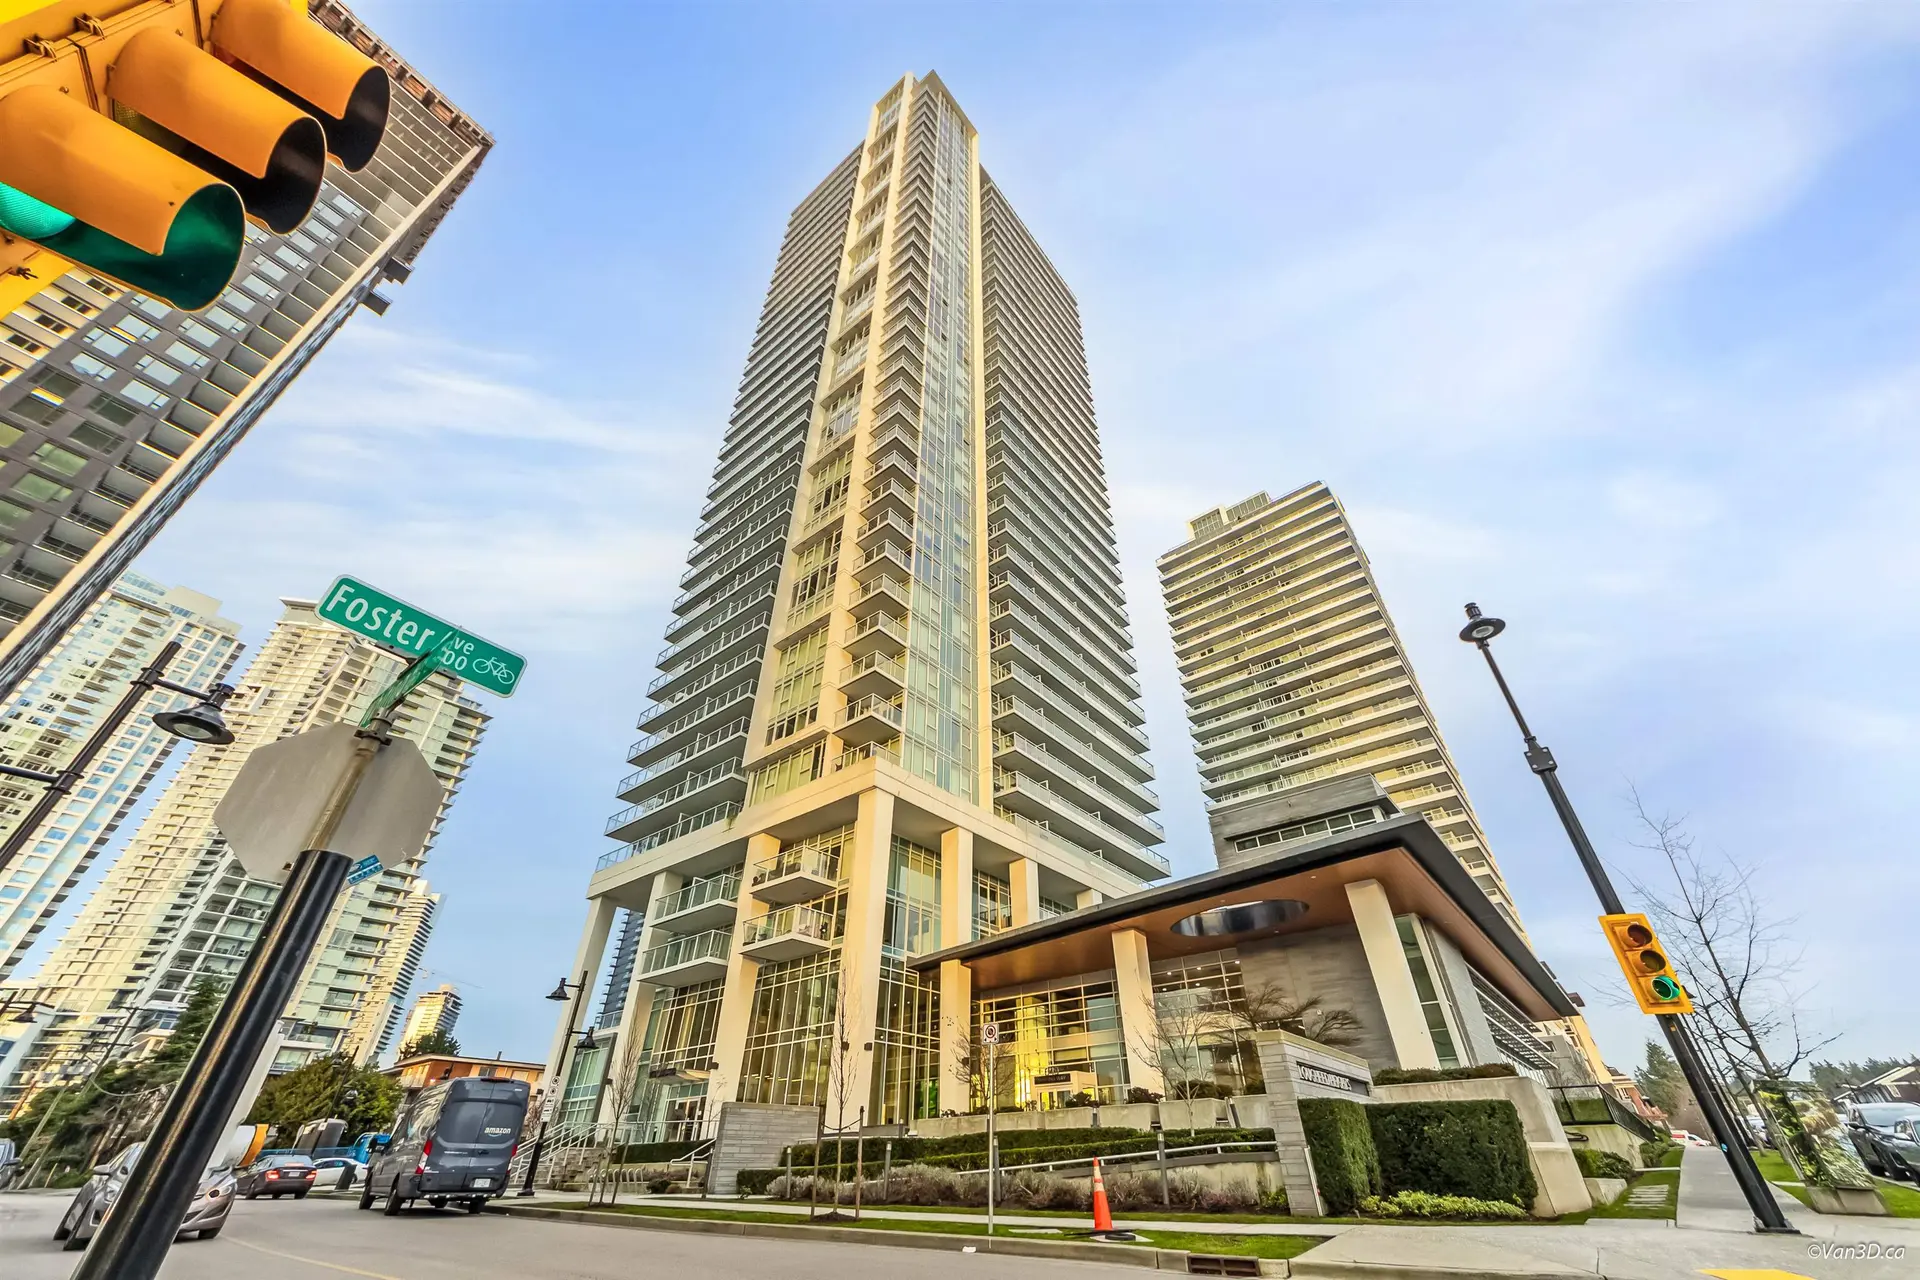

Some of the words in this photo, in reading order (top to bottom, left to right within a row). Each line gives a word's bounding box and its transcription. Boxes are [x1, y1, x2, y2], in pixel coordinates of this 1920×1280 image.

[326, 584, 435, 651] Foster
[453, 636, 475, 655] ve
[442, 647, 468, 671] 00
